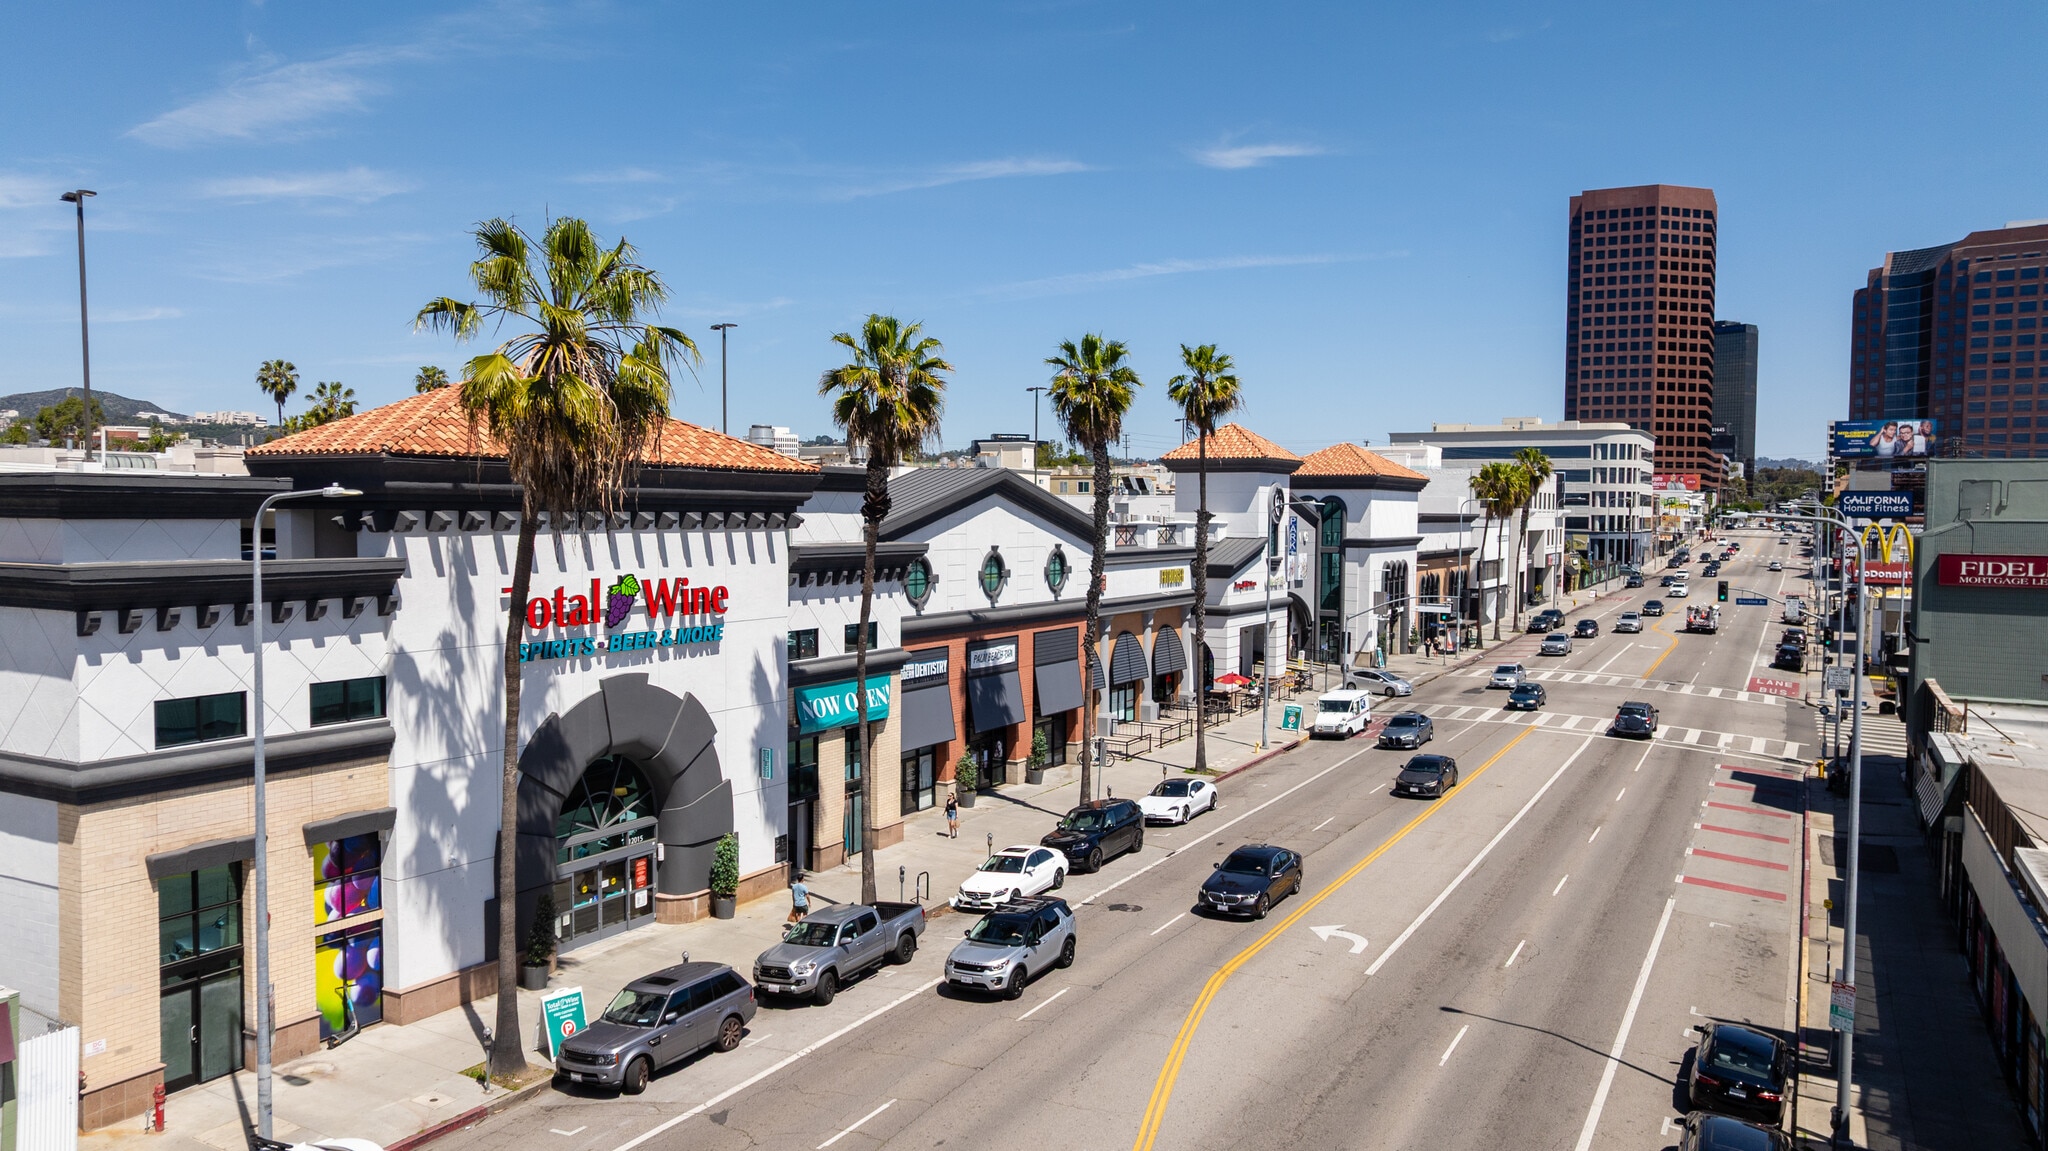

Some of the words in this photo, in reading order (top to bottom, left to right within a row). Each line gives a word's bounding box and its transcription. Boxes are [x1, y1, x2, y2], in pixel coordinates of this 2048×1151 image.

[1843, 495, 1910, 504] CALIFORNIA
[1843, 504, 1872, 512] Home
[1874, 504, 1910, 512] Fitness
[1289, 517, 1297, 550] PARK
[1960, 561, 2048, 578] FIDEL
[1959, 576, 2029, 585] MORTGAGE
[501, 577, 601, 630] otal
[641, 577, 729, 619] Wine
[520, 637, 596, 663] SPIRITS
[609, 630, 657, 653] BEER
[661, 630, 673, 647] &
[677, 624, 725, 645] MORE
[914, 660, 948, 678] DENTISTRY
[1756, 678, 1793, 689] LANE
[1759, 687, 1788, 696] BUS
[802, 695, 841, 721] NOW
[844, 684, 890, 712] OEN!
[547, 999, 561, 1010] Total
[565, 995, 580, 1005] Wine
